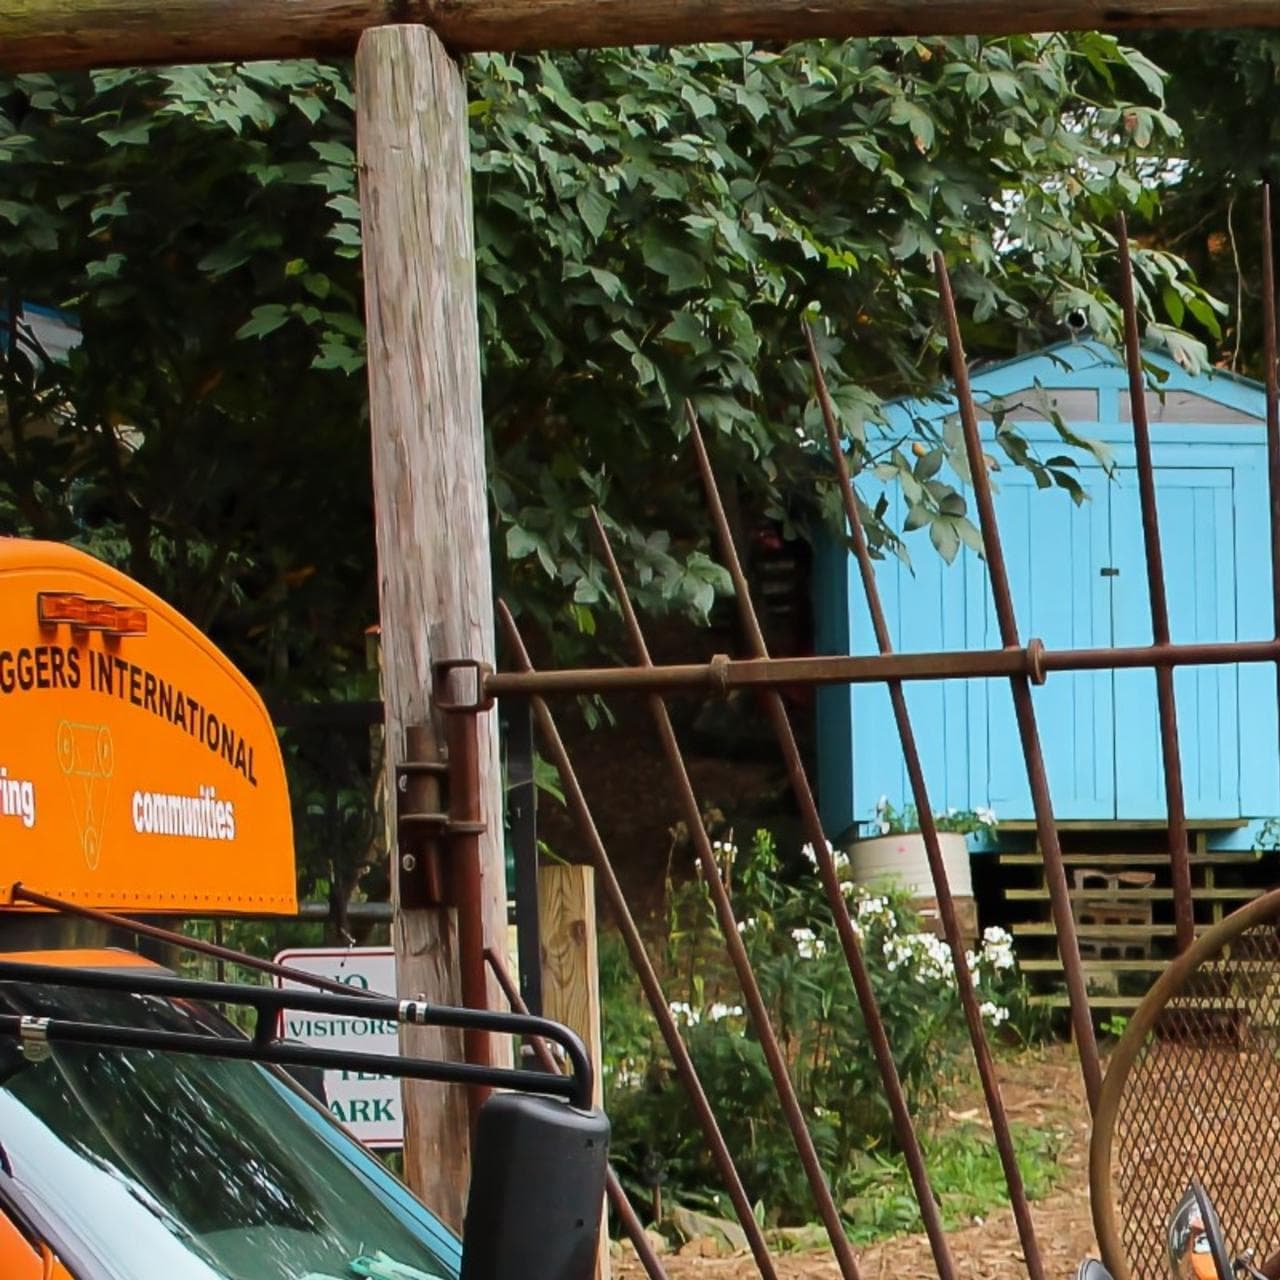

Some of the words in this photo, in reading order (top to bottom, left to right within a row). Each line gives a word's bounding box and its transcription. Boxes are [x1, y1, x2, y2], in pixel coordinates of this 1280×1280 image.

[0, 646, 81, 694] GGERS
[88, 649, 258, 787] INTERNATIONAL
[0, 767, 35, 828] ing
[132, 784, 235, 841] communities
[290, 1019, 398, 1036] VISITORS
[330, 1098, 396, 1122] ARK
